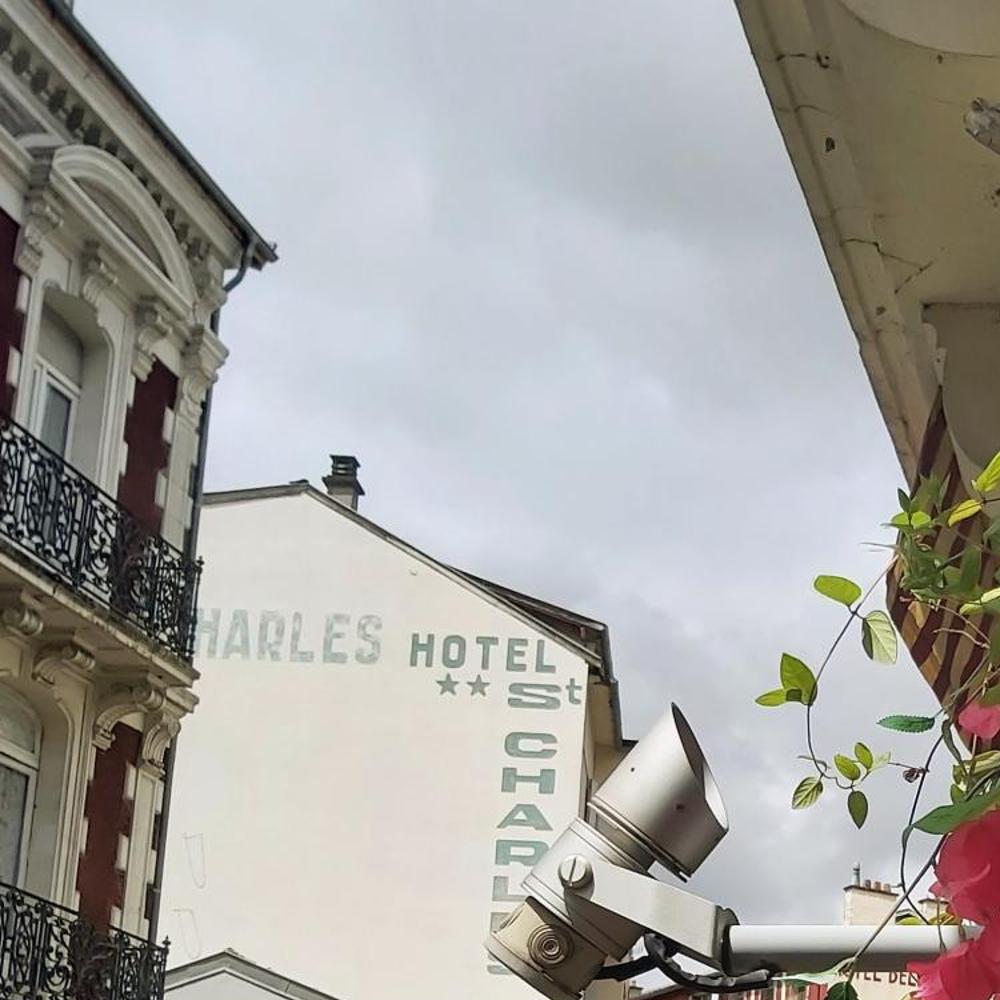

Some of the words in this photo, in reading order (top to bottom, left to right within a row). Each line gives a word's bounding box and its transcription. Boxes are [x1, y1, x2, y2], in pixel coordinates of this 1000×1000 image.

[195, 608, 383, 665] HARLES
[409, 633, 557, 674] HOTEL
[486, 732, 558, 975] CHARL
